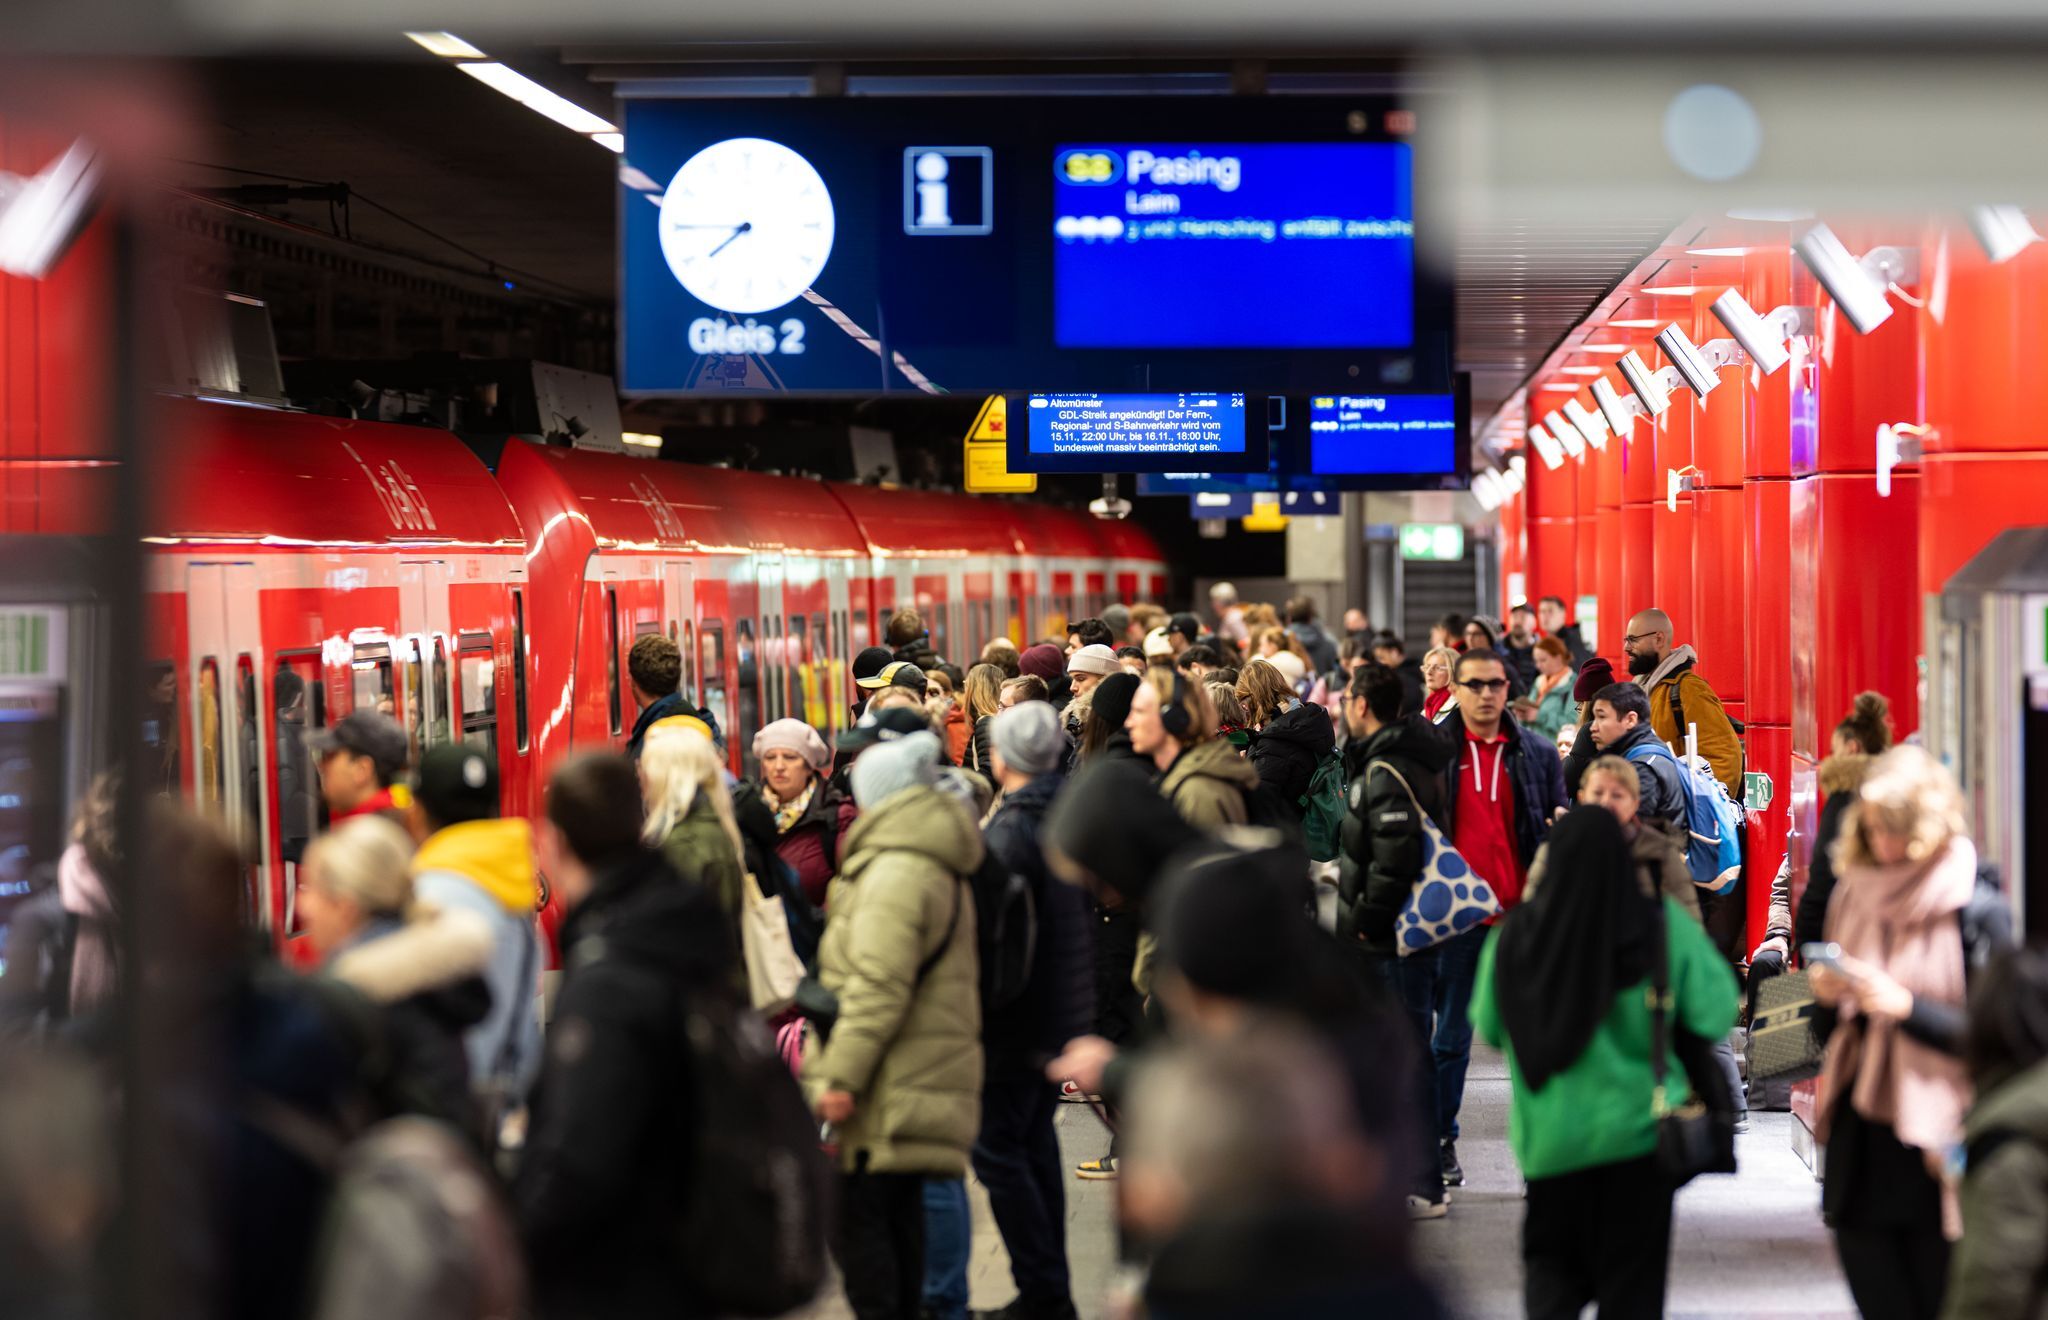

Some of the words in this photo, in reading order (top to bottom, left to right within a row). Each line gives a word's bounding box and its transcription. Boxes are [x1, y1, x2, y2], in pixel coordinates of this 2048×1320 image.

[1127, 150, 1241, 192] Pasing
[688, 317, 776, 354] Gleis
[779, 318, 806, 354] 2
[1050, 399, 1103, 408] Altomünster
[1178, 398, 1186, 408] 2
[1231, 398, 1244, 408] 24
[1339, 396, 1386, 412] Pasing
[1058, 410, 1108, 420] GDL-Streik
[1109, 410, 1166, 421] angekündigt!
[1167, 410, 1184, 419] Der
[1050, 421, 1093, 431] Regional-
[1094, 421, 1112, 430] und
[1113, 421, 1180, 430] S-Bahnverkehr
[1181, 421, 1200, 430] wird
[1201, 422, 1221, 430] vom
[1050, 432, 1081, 442] 15.11.,
[1081, 432, 1107, 441] 22:00
[1108, 432, 1128, 442] Uhr,
[1129, 432, 1143, 441] bis
[1144, 432, 1174, 442] 16.11.,
[1176, 432, 1201, 441] 18:00
[1202, 432, 1222, 442] Uhr,
[1054, 442, 1104, 452] bundesweit
[1105, 443, 1137, 452] massiv
[1138, 442, 1198, 453] beeinträchtigt
[1199, 442, 1221, 452] sein.
